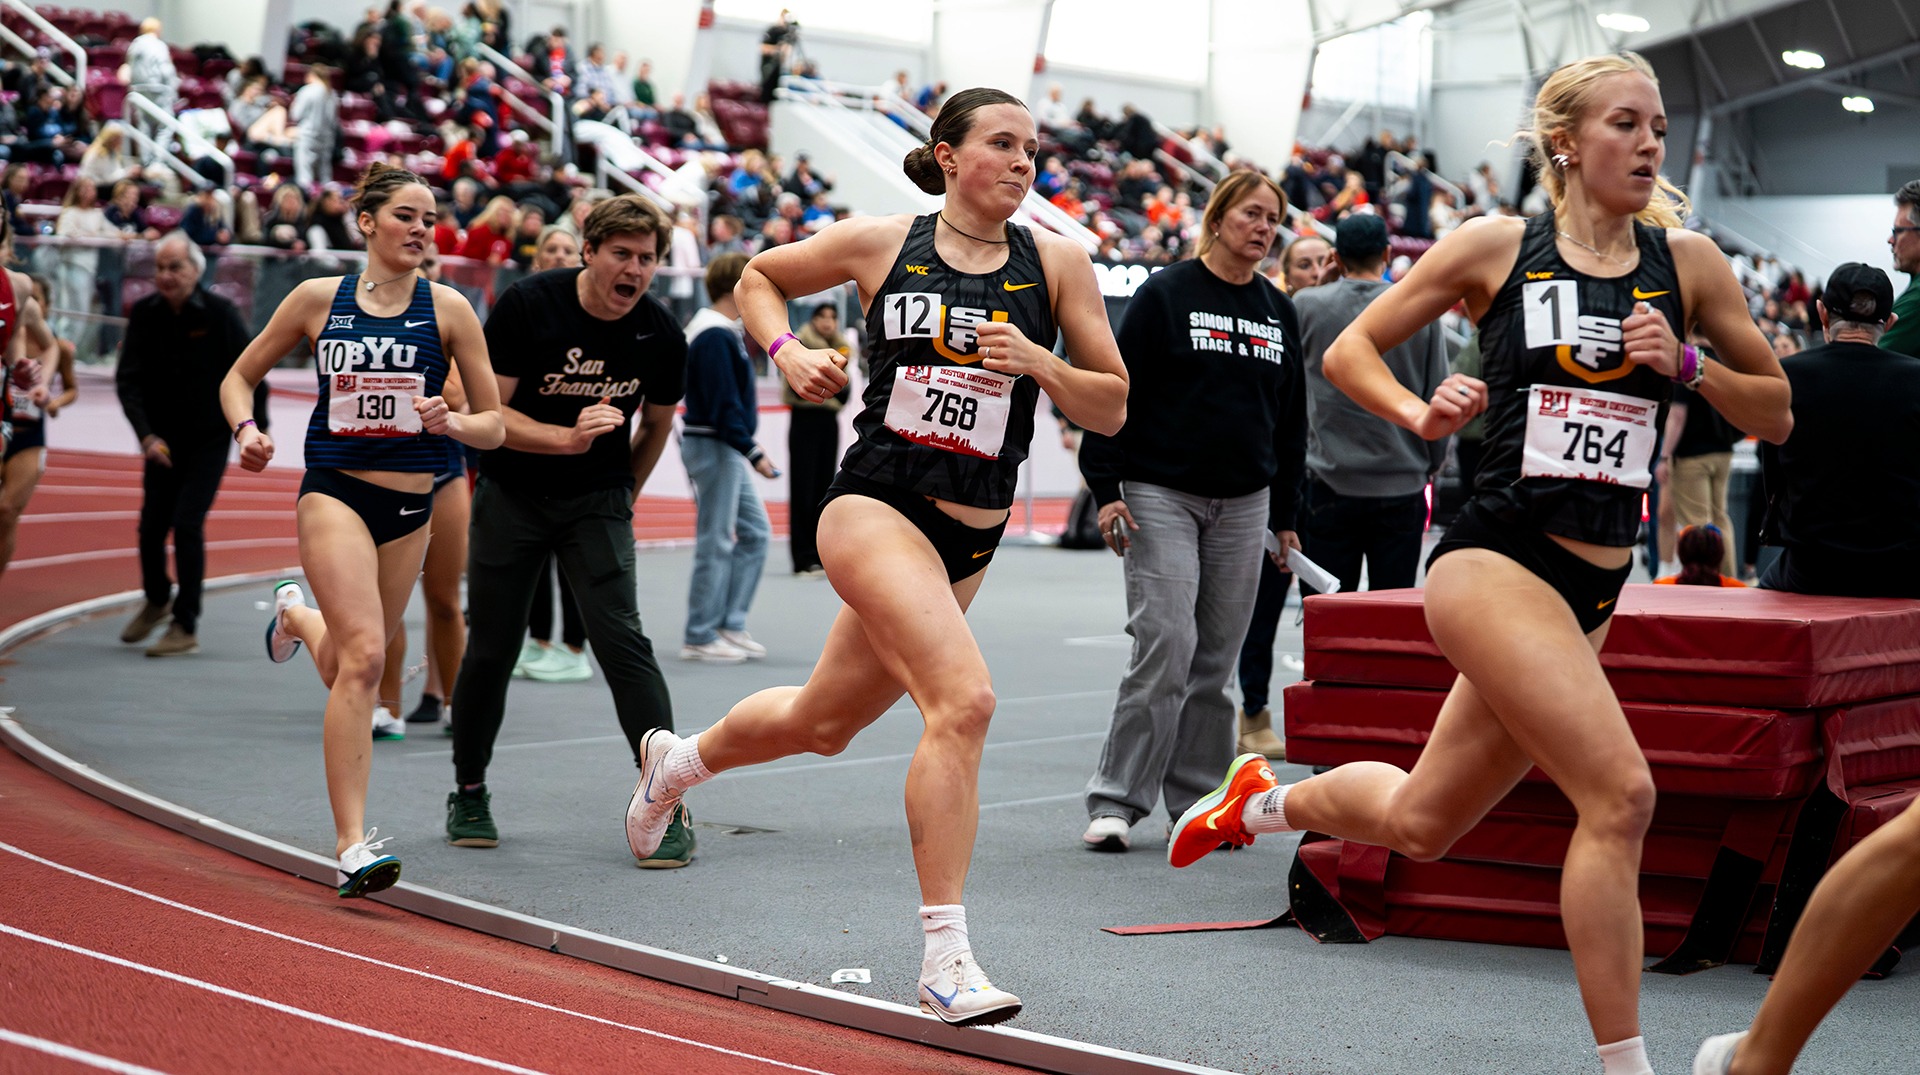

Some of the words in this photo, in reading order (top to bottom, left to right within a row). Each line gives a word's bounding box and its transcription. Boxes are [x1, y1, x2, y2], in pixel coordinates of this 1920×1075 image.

[906, 264, 929, 275] WCC
[894, 295, 931, 335] 12
[1539, 285, 1562, 340] 1
[1189, 311, 1233, 332] SIMON
[1237, 318, 1282, 343] FRASER
[322, 342, 346, 372] 10
[351, 337, 418, 369] BYU
[563, 347, 605, 375] San
[1192, 337, 1233, 354] TRACK
[1238, 342, 1249, 356] &
[1253, 345, 1282, 365] FIELD
[336, 375, 357, 390] BU
[539, 373, 640, 397] Francisco
[940, 368, 966, 379] BOSTON
[966, 373, 1004, 389] UNIVERSITY
[357, 394, 395, 420] 130
[922, 387, 978, 431] 768
[1540, 390, 1572, 413] BU
[1563, 421, 1629, 468] 764
